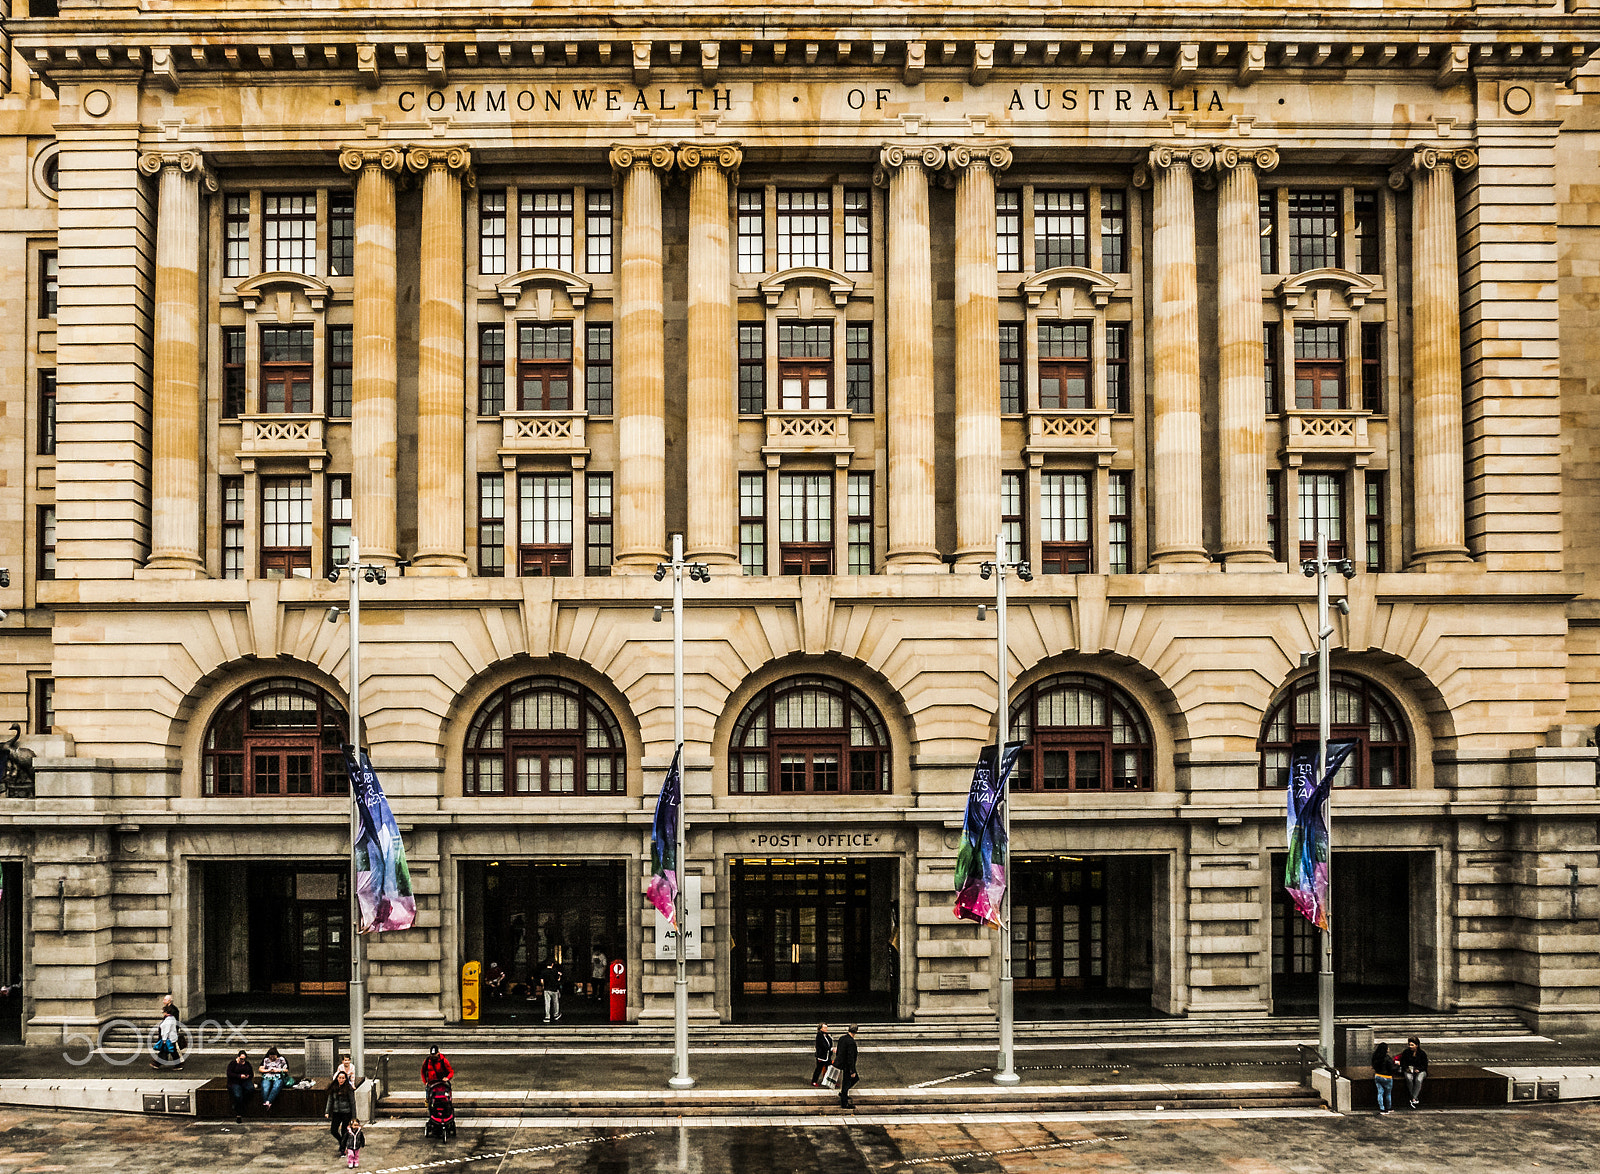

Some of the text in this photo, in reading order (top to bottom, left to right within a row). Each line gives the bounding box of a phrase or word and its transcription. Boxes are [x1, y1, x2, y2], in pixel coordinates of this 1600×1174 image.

[397, 88, 1224, 113] COMMONWEALTH OF AUSTRALIA
[758, 834, 873, 847] POST OFFICE
[664, 930, 693, 939] AEM
